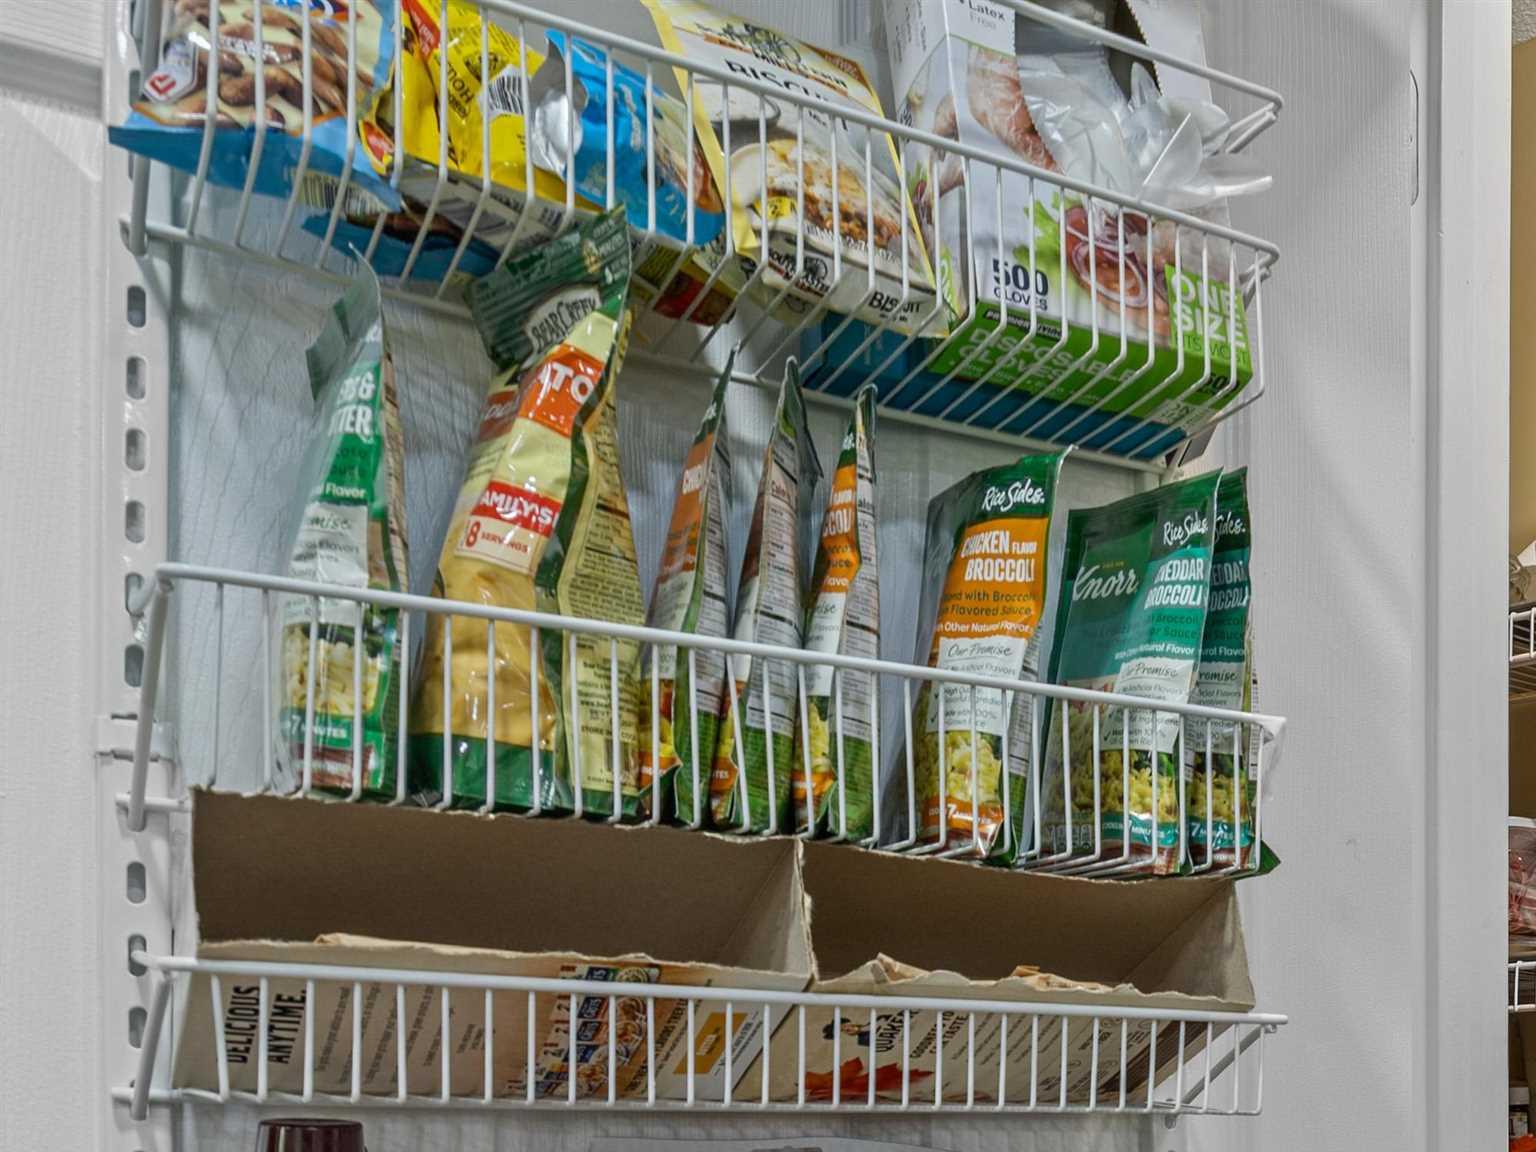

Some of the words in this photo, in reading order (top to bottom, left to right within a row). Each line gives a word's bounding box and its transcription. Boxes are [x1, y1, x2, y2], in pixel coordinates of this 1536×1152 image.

[992, 258, 1048, 298] 500
[1171, 274, 1242, 308] ONE
[1172, 303, 1246, 350] SIZE
[982, 486, 1006, 511] Rice
[465, 521, 480, 548] 8
[961, 531, 1009, 559] CHICKEN
[1163, 521, 1183, 546] Rice
[965, 558, 1035, 583] BROCCOLI
[1073, 566, 1138, 602] Knorr
[966, 589, 990, 602] with
[992, 590, 1036, 604] Broccoli
[945, 621, 969, 633] Other
[223, 984, 261, 1064] DELICIOUS
